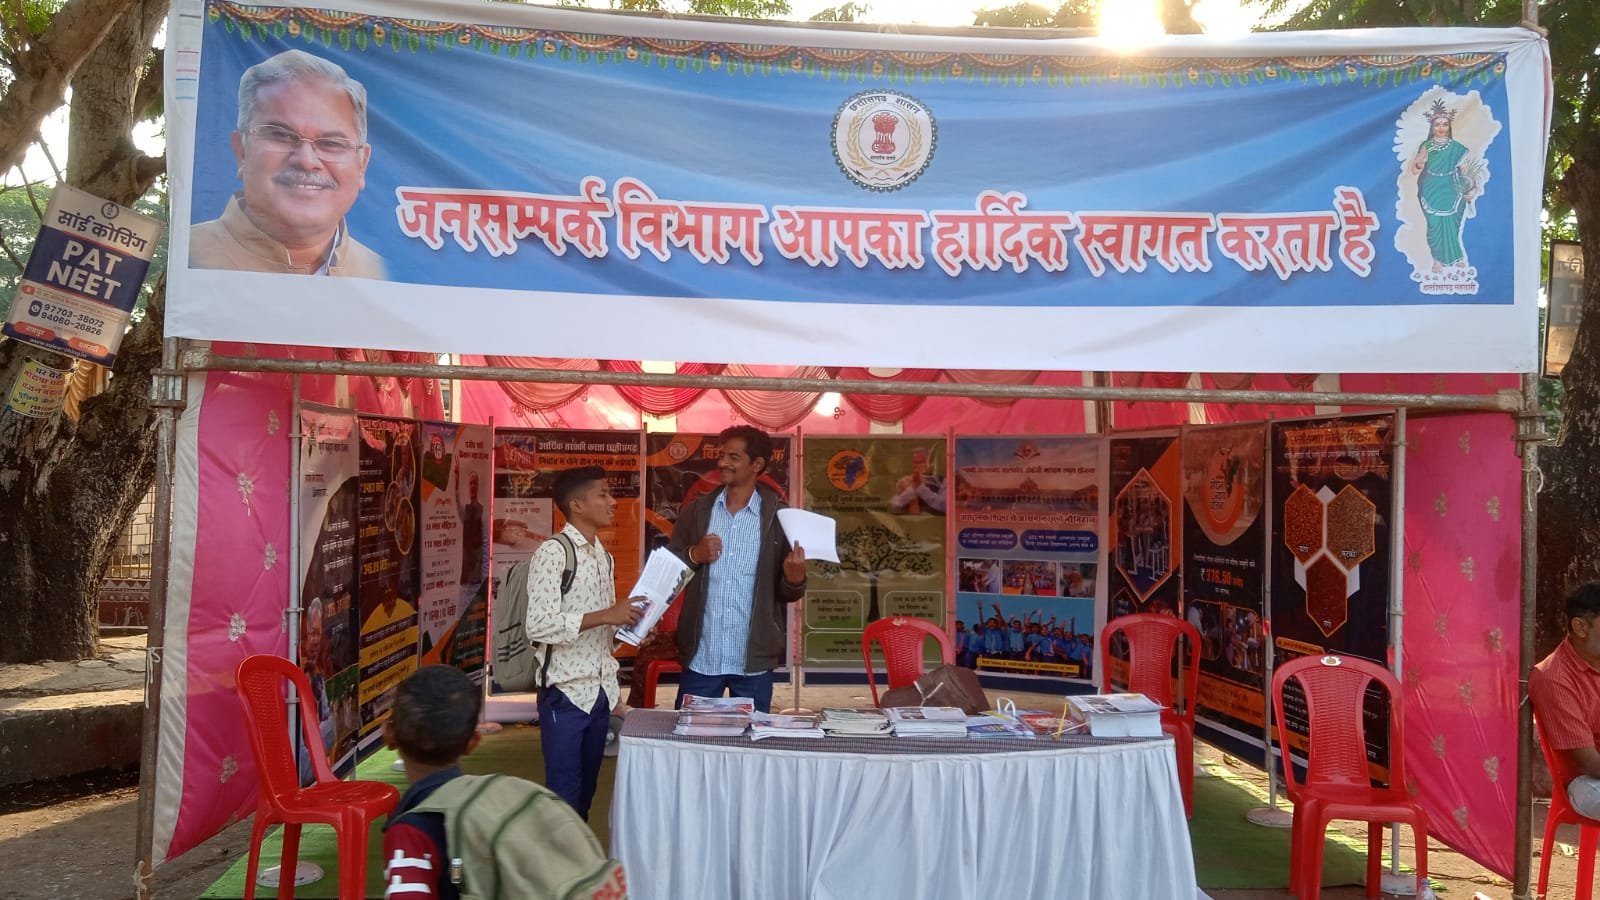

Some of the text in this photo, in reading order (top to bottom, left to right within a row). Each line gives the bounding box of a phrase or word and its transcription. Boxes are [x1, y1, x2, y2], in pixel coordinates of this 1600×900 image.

[92, 220, 148, 252] कोचिंग
[397, 177, 1379, 280] जनसम्पर्क विभाग आपका हार्दिक स्वागत करता है
[63, 240, 123, 275] PAT
[47, 261, 122, 300] NEET
